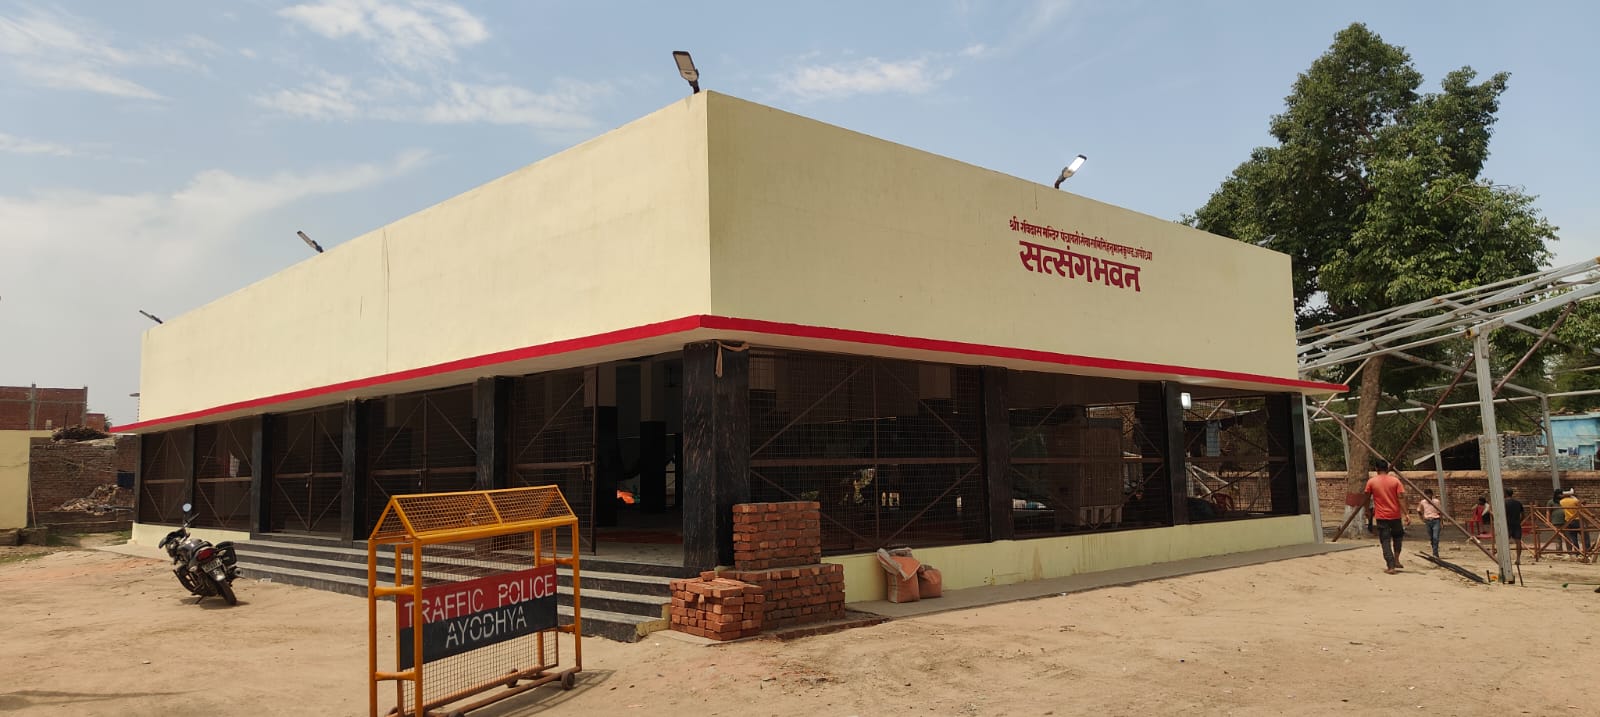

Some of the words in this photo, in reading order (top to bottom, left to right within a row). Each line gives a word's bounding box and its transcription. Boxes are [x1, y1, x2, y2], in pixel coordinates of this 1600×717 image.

[1010, 216, 1019, 231] श्री
[1020, 219, 1042, 237] रविदास
[404, 588, 484, 628] TRAFFIC
[498, 574, 554, 608] POLICE
[445, 605, 527, 649] AYODHYA
